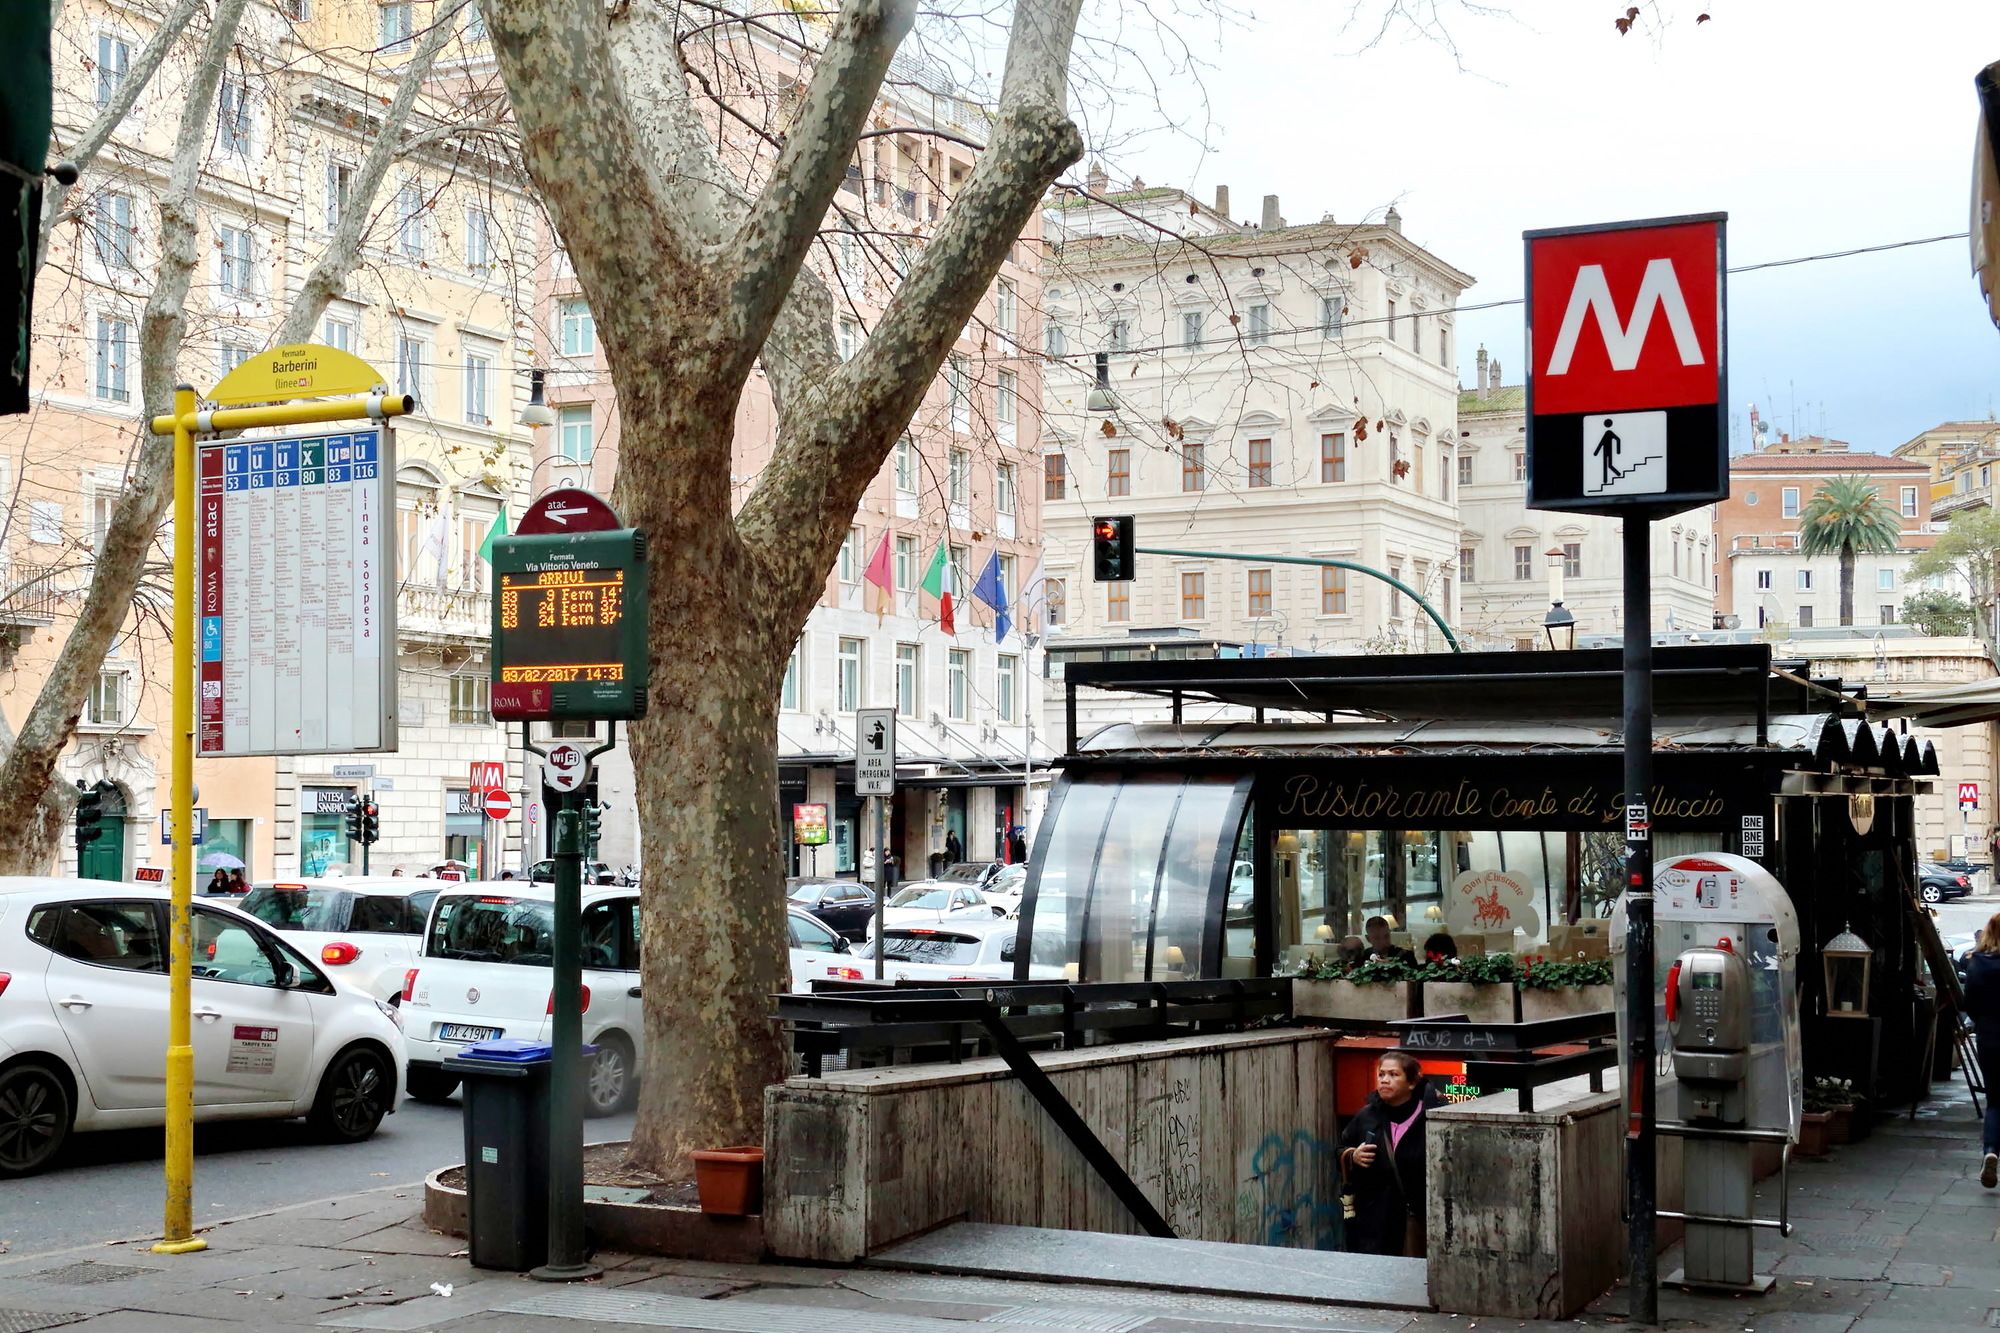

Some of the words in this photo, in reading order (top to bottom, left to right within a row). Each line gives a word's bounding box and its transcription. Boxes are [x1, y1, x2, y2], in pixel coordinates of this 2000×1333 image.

[1546, 258, 1705, 376] M
[272, 358, 317, 373] Barberini
[303, 470, 315, 483] 80
[329, 468, 341, 481] 83
[356, 464, 374, 478] 116
[227, 477, 239, 489] 53
[252, 474, 264, 487] 61
[278, 472, 289, 485] 63
[547, 501, 567, 509] atac
[207, 502, 217, 537] atac
[526, 563, 538, 572] Via
[540, 562, 571, 571] Vittorio
[572, 561, 599, 570] Veneto
[539, 571, 584, 585] ARRIVI
[207, 571, 217, 612] ROMA
[502, 592, 517, 602] 83
[547, 590, 555, 601] 9
[561, 589, 594, 601] Ferm
[502, 603, 517, 615] 53
[539, 602, 555, 614] 24
[561, 600, 594, 613] Ferm
[502, 616, 517, 628] 63
[539, 614, 555, 627] 24
[561, 613, 594, 626] Ferm
[204, 641, 213, 649] 80
[502, 668, 579, 683] 09/02/2017
[587, 667, 624, 680] 14:31
[494, 697, 521, 708] ROMA
[868, 758, 882, 767] AREA
[471, 767, 481, 786] M
[484, 767, 502, 786] M
[859, 770, 890, 779] EMERGENZA
[318, 792, 344, 801] INTESA
[1278, 774, 1482, 818] Ristorante
[1489, 786, 1559, 818] Conte
[1567, 786, 1599, 816] di
[1605, 785, 1724, 821] Gluccio
[1960, 786, 1977, 798] M
[317, 803, 348, 813] SANPAO
[1744, 817, 1762, 827] BNE
[1744, 831, 1762, 842] BNE
[1744, 845, 1762, 855] BNE
[138, 869, 162, 880] TAXI
[1461, 877, 1481, 895] Don
[447, 1025, 460, 1037] DX
[462, 1027, 493, 1041] 419WT
